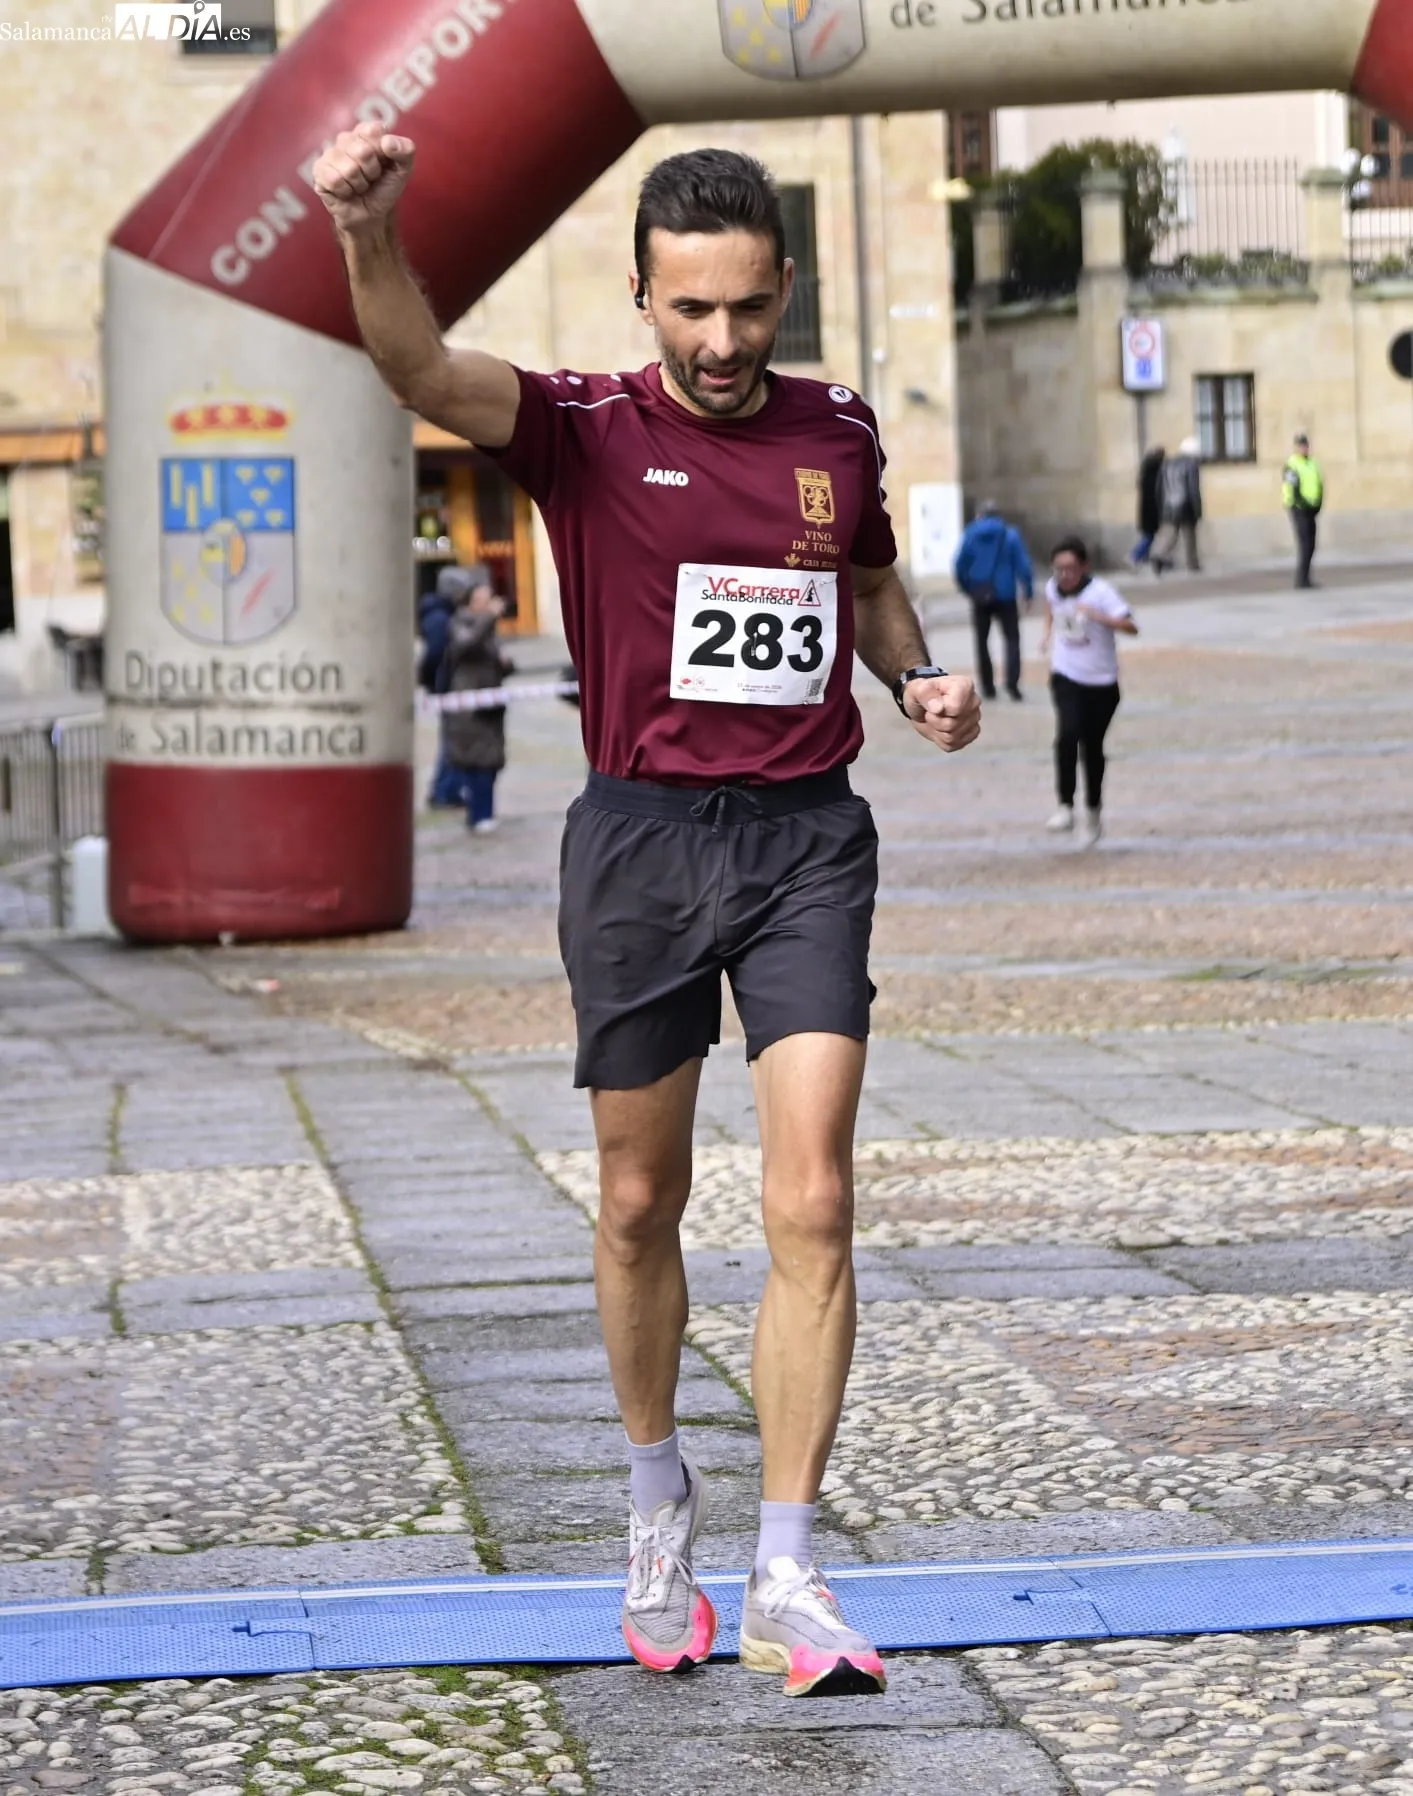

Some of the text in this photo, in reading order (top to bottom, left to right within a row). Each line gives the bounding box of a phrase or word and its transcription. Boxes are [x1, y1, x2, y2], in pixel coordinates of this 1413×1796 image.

[889, 0, 937, 29] de
[210, 0, 515, 286] CON DEPOR
[642, 468, 690, 487] JAKO
[792, 540, 840, 554] DE TORO
[805, 530, 832, 542] VINO
[687, 609, 824, 673] 283
[124, 650, 343, 699] Diputación
[150, 710, 366, 756] Salamanca
